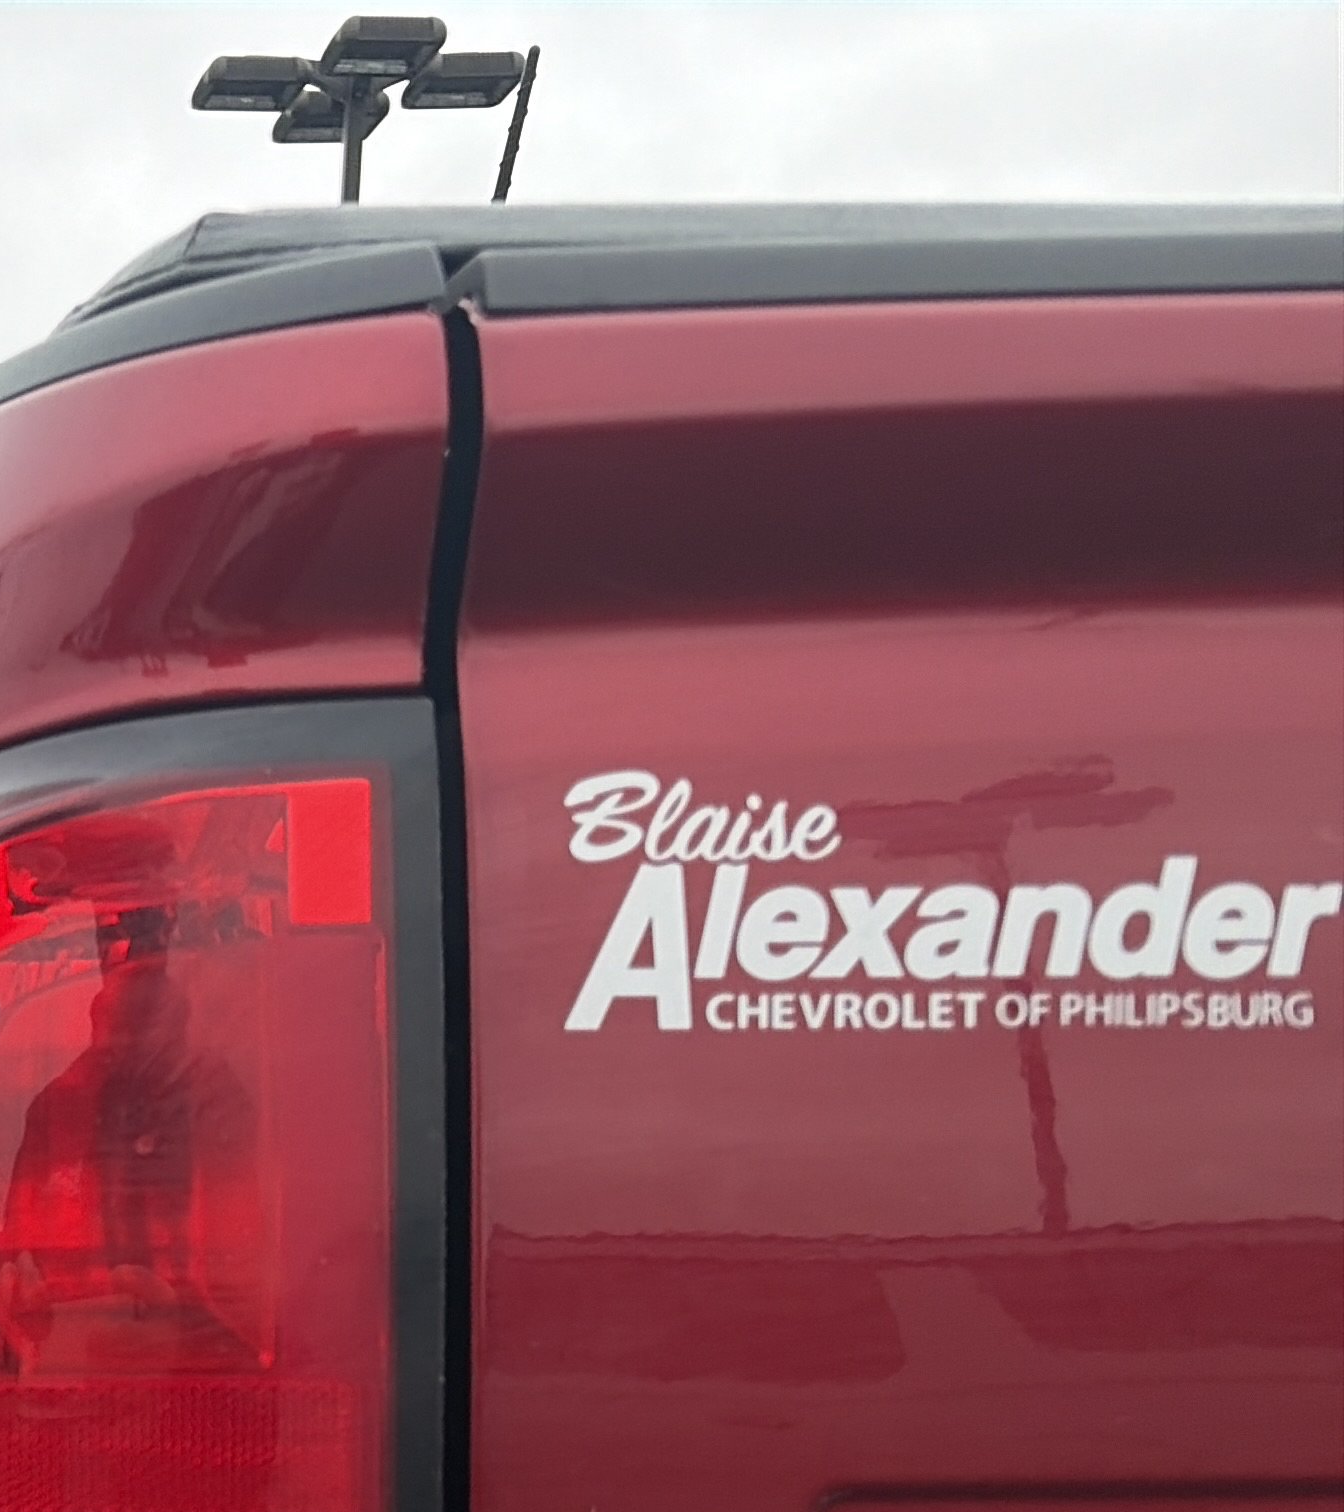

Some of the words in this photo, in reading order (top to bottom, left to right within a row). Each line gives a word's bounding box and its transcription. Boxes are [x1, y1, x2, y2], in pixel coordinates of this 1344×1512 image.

[564, 769, 841, 863] Blaise
[564, 855, 1344, 1032] Alexander
[706, 991, 984, 1030] CHEVROLET
[996, 991, 1052, 1028] OF
[1060, 991, 1315, 1028] PHILIPSBURG
